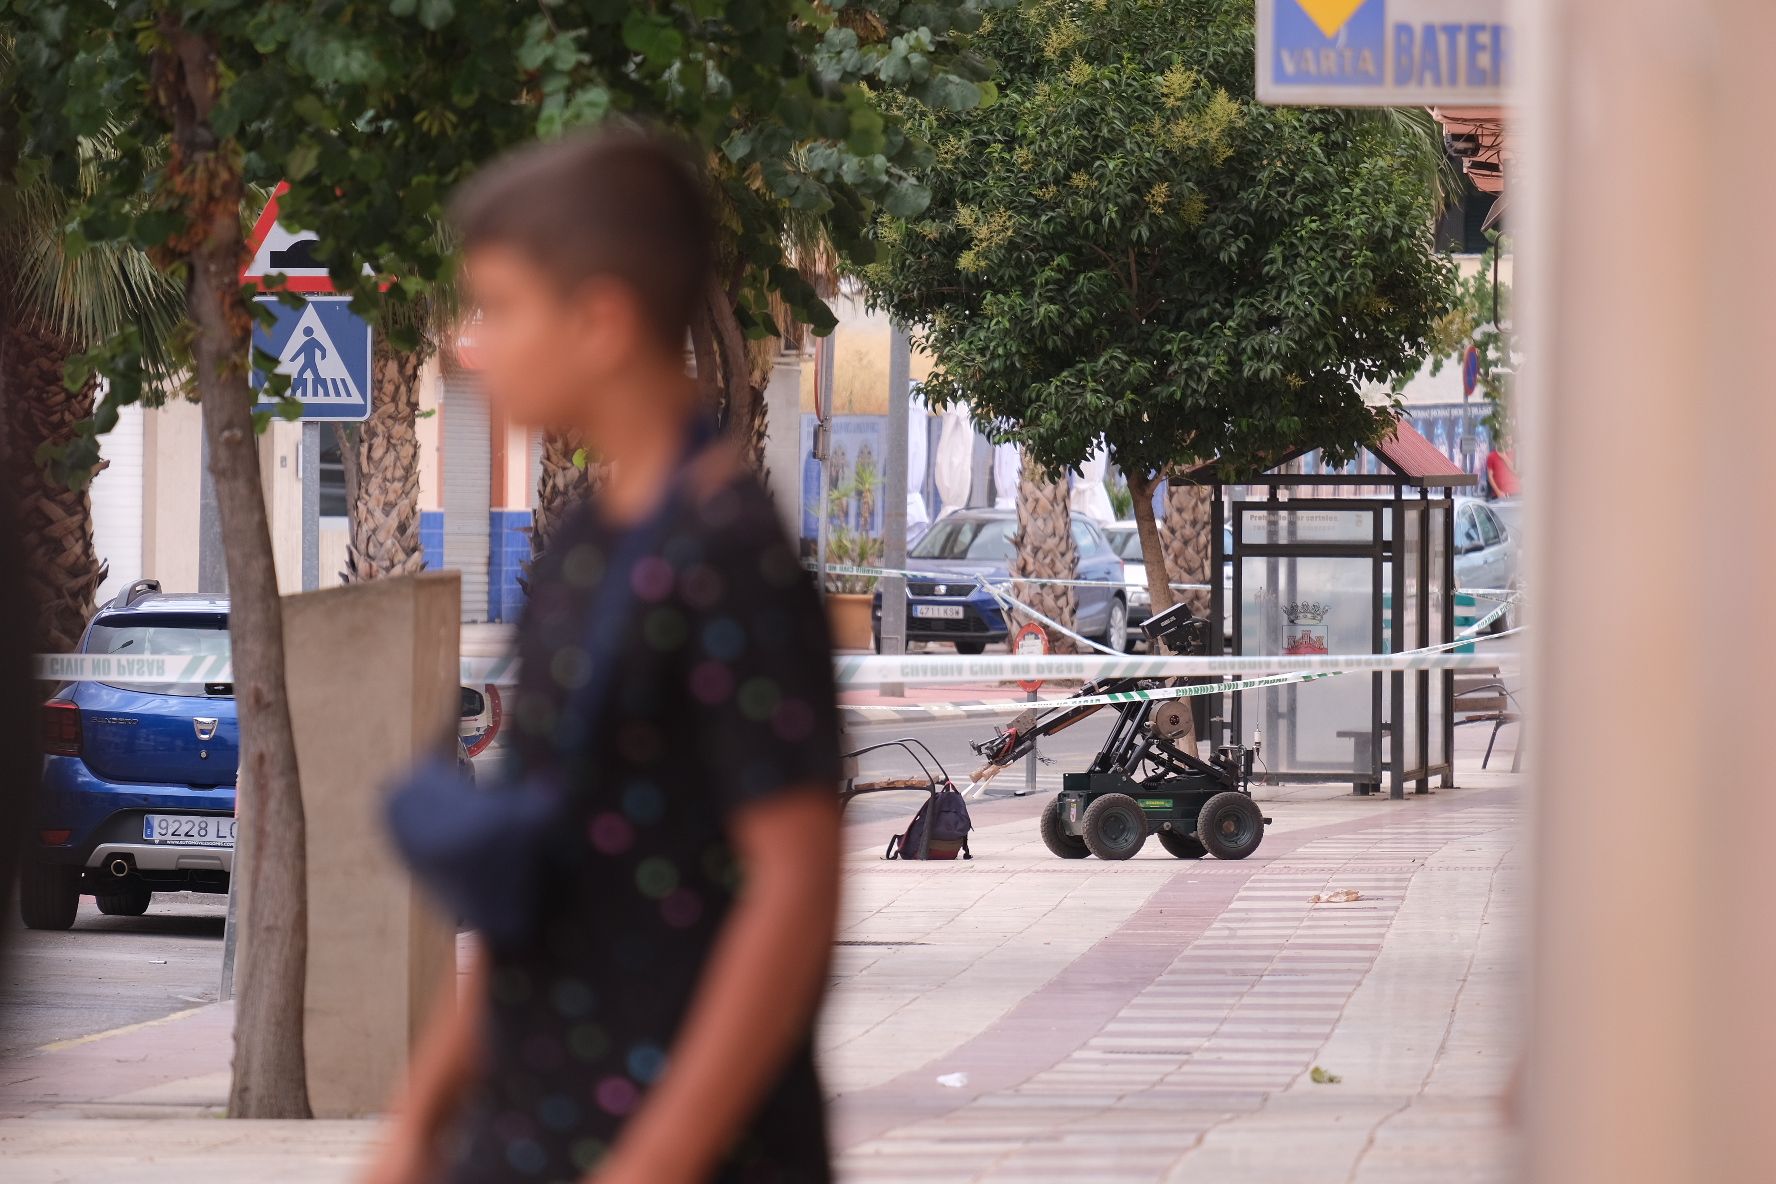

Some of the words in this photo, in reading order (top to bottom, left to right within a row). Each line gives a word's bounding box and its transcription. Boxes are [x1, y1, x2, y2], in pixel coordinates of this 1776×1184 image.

[1281, 48, 1376, 77] VARTA
[919, 607, 940, 617] 4711
[1175, 686, 1214, 697] GUARDIA
[1217, 682, 1239, 692] CIVIL
[158, 819, 208, 838] 9228
